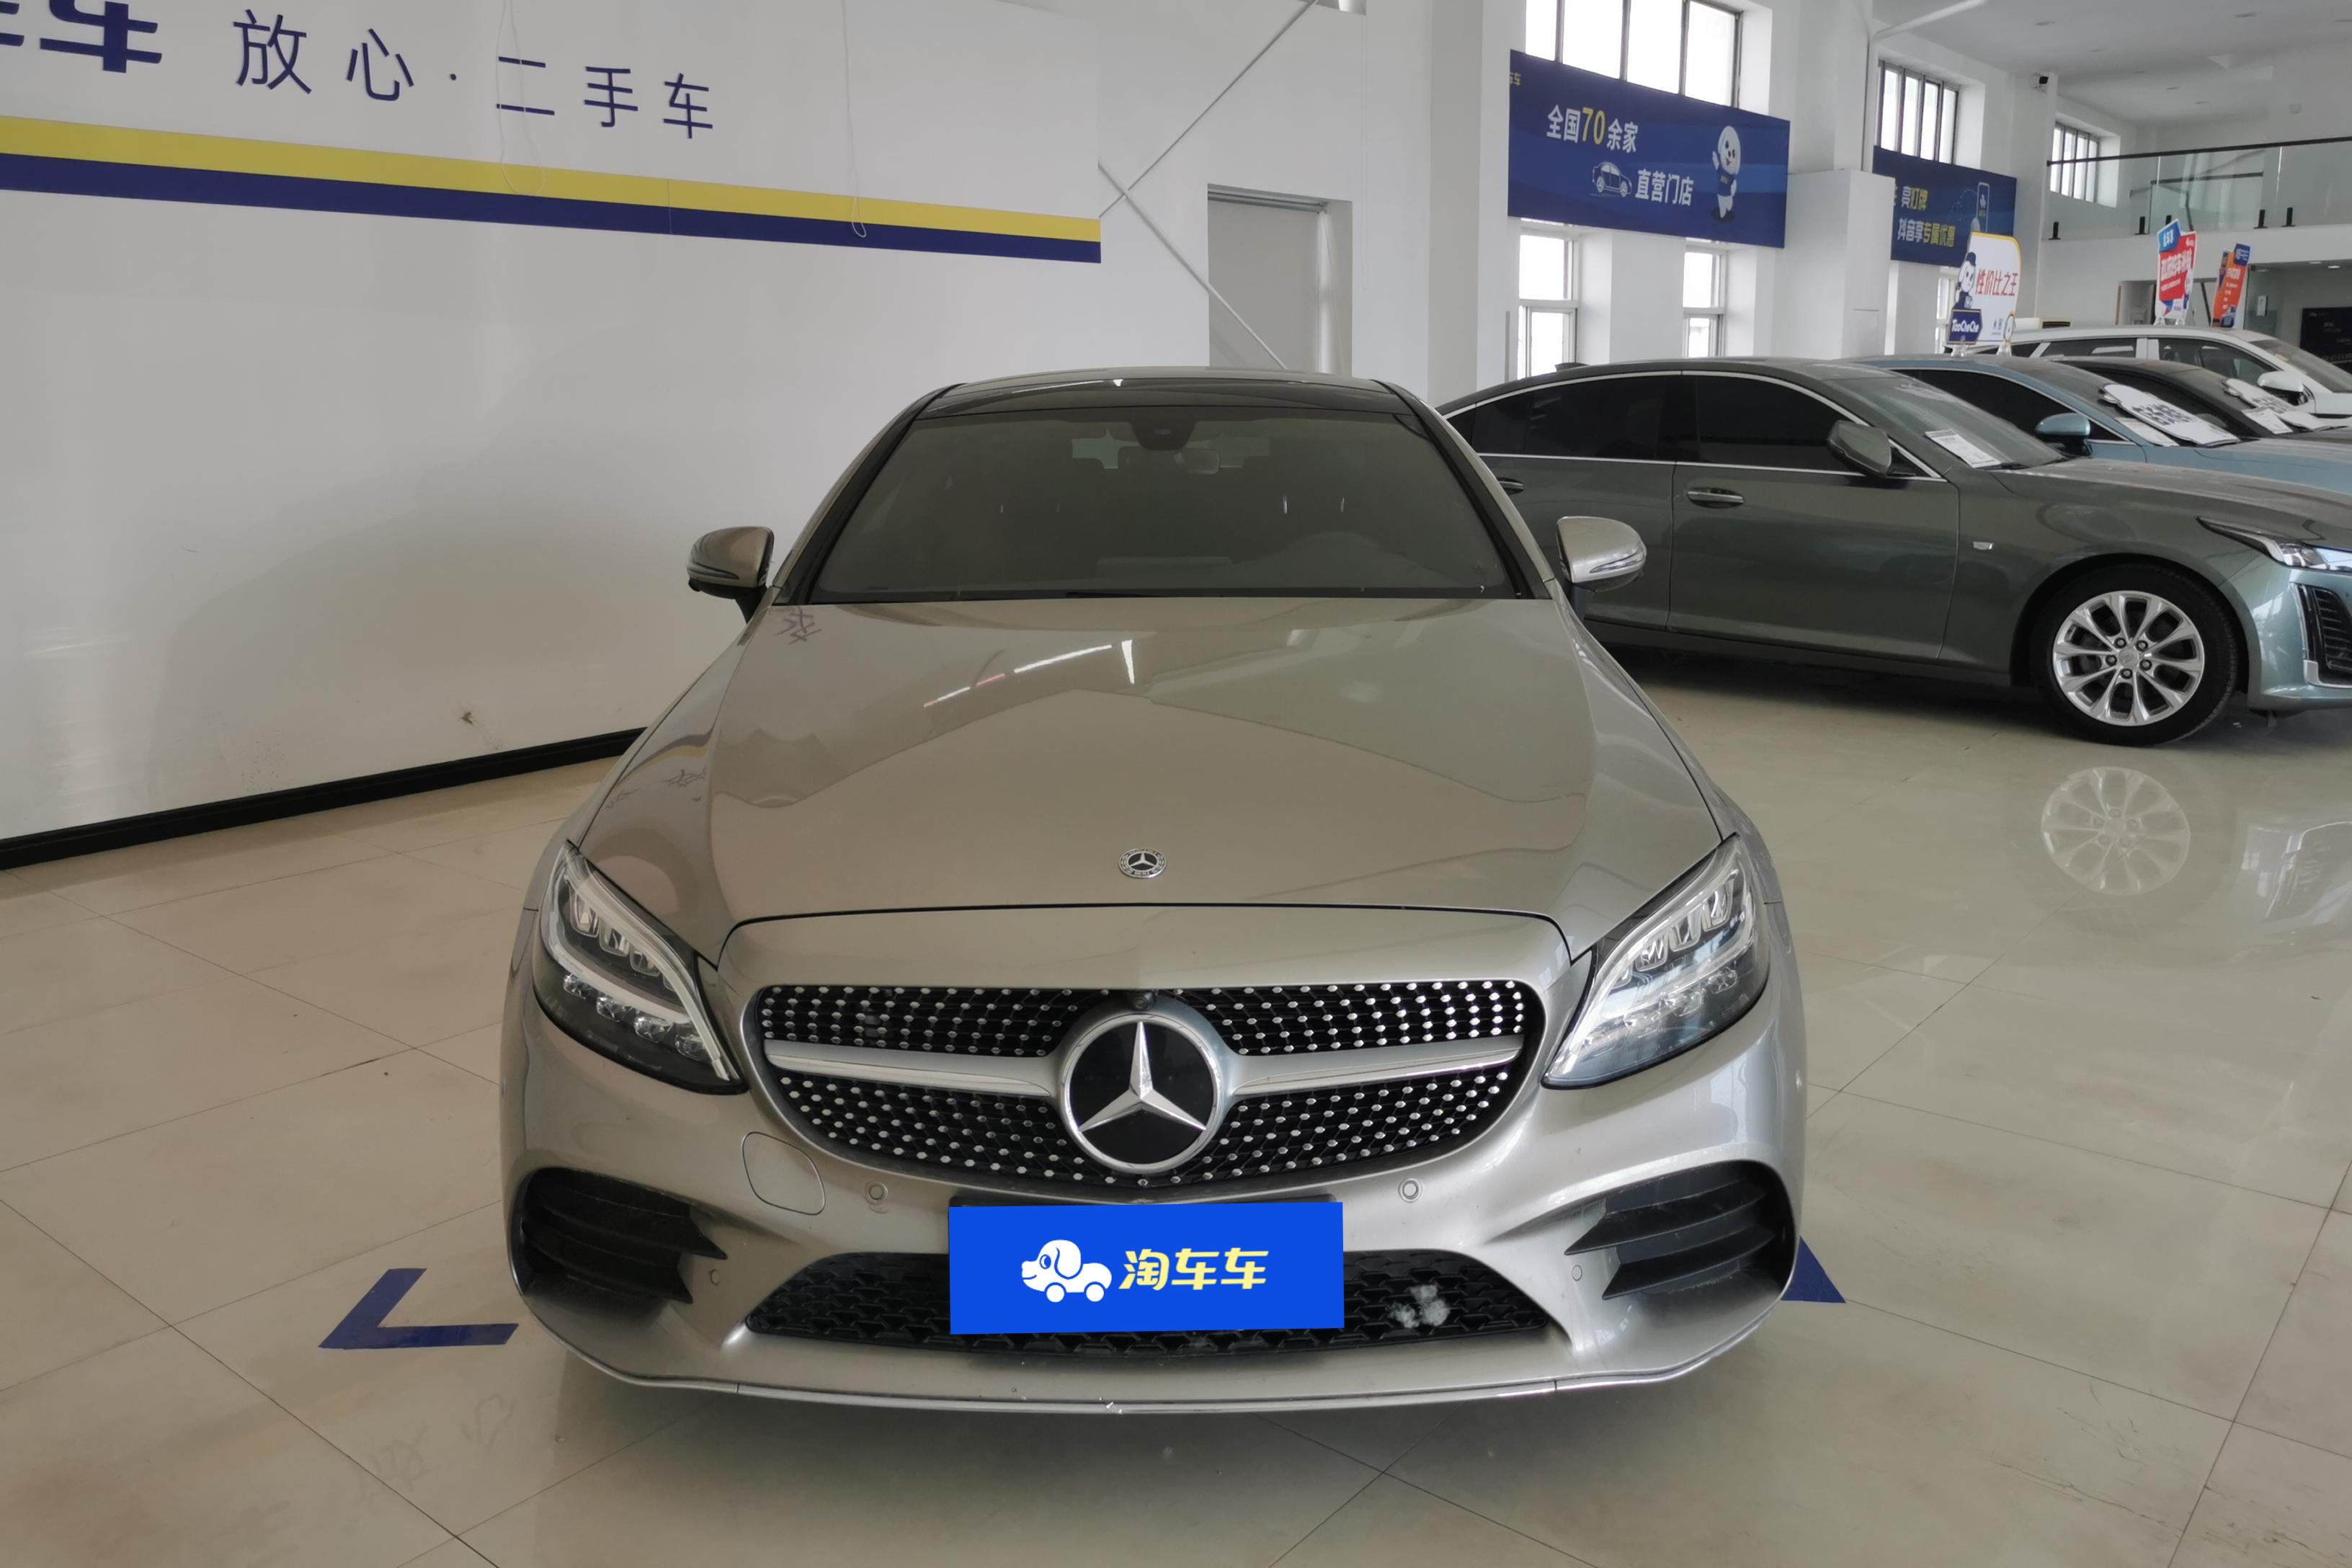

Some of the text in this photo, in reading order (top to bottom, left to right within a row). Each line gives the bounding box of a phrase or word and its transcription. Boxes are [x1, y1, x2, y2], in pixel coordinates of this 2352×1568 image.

[1546, 104, 1639, 153] 全国70余家
[1634, 168, 1695, 207] 直营门店
[1975, 268, 2018, 296] 性价比之王
